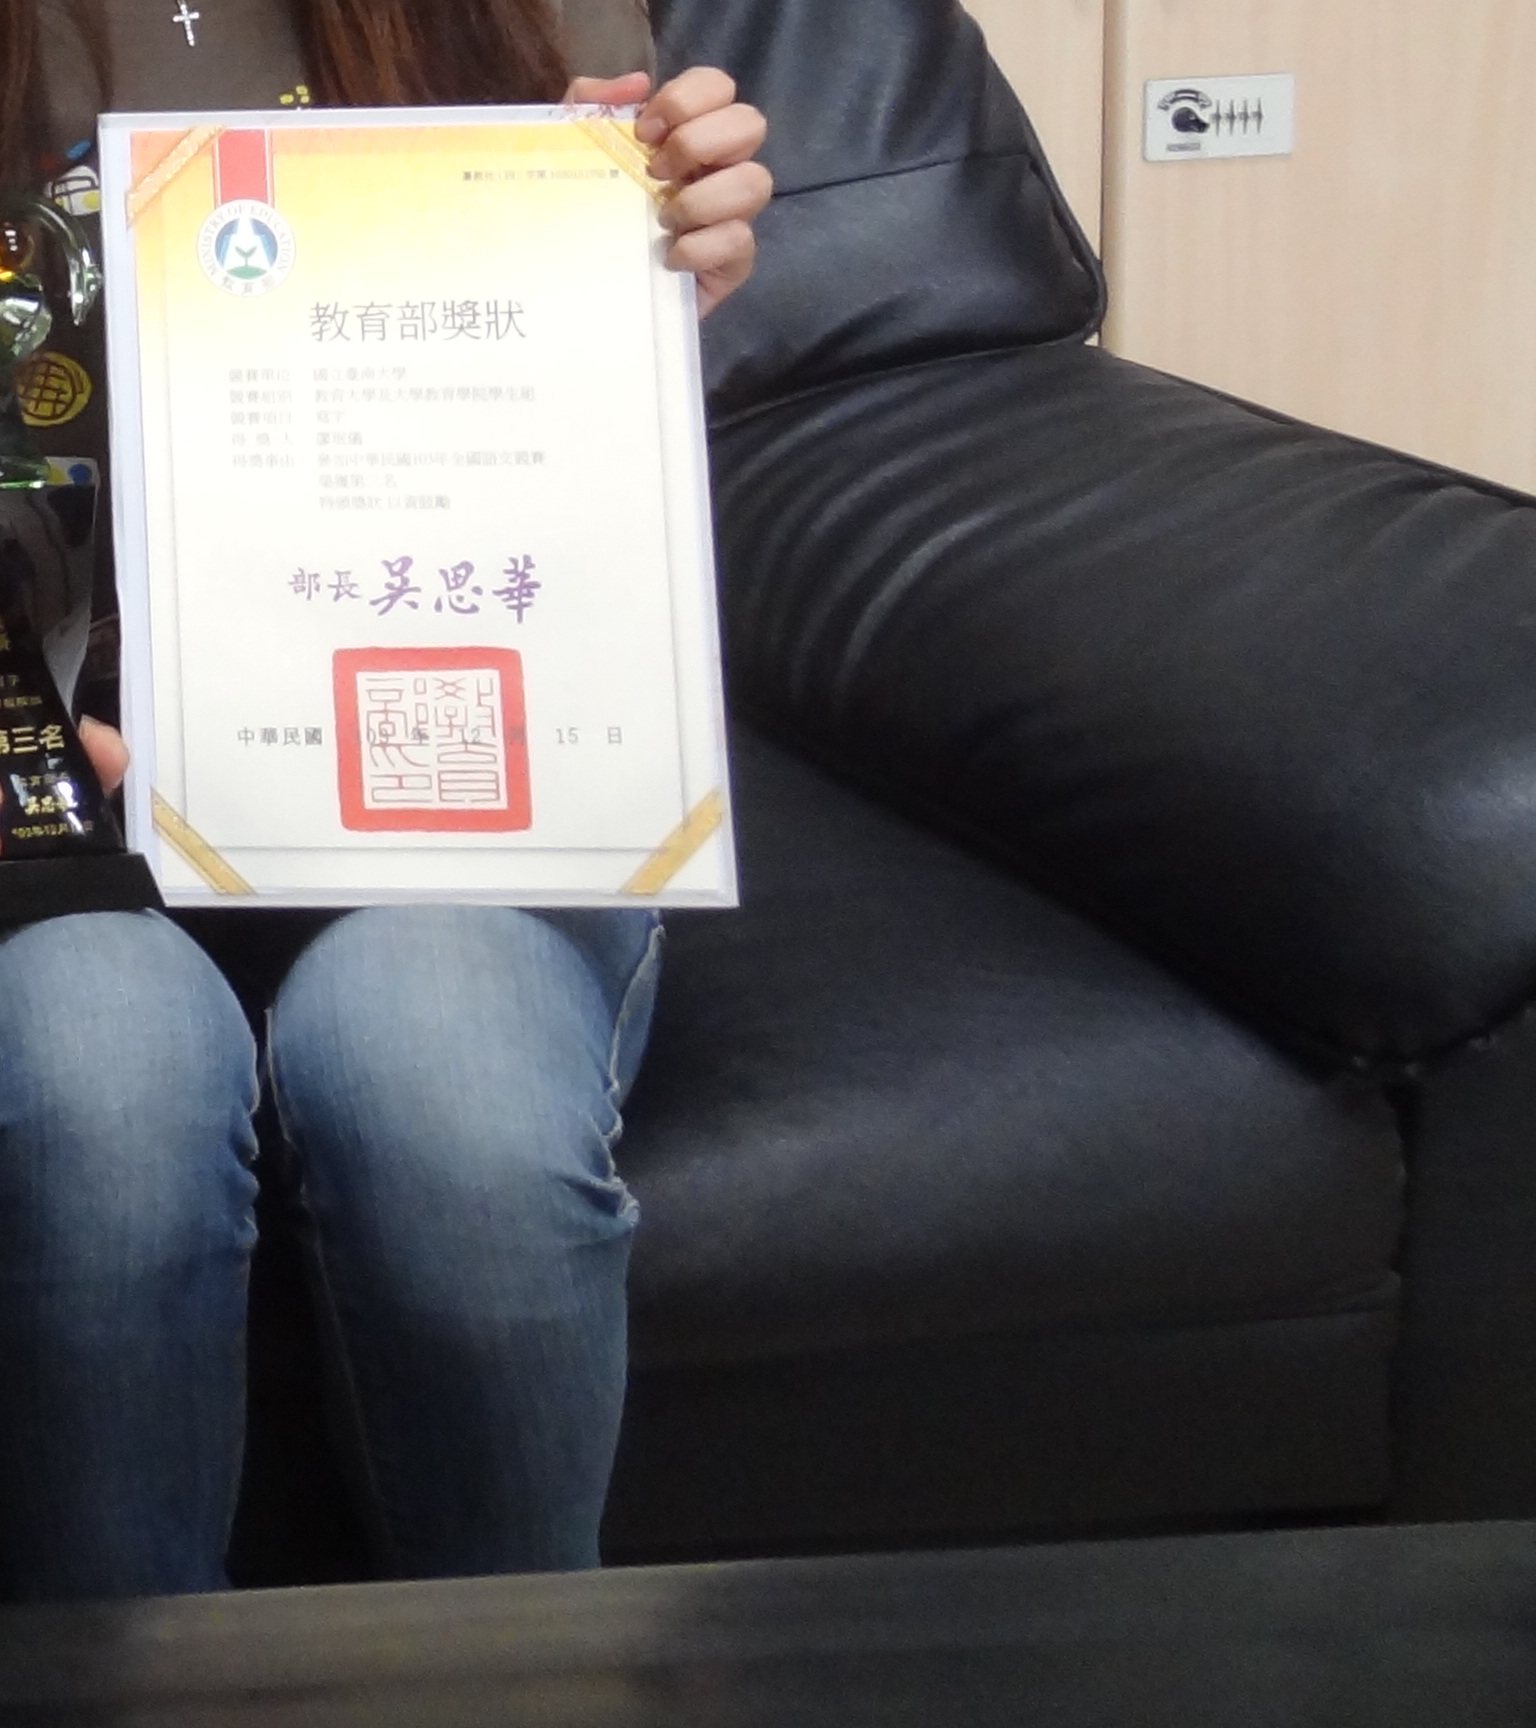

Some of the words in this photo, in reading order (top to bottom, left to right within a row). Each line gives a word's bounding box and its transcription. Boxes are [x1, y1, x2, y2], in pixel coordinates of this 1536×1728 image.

[309, 299, 528, 343] 教育部獎狀
[287, 567, 361, 602] 部長
[369, 555, 543, 624] 吳思華
[236, 727, 324, 746] 中華民國
[555, 727, 579, 745] 15
[607, 727, 623, 745] 日
